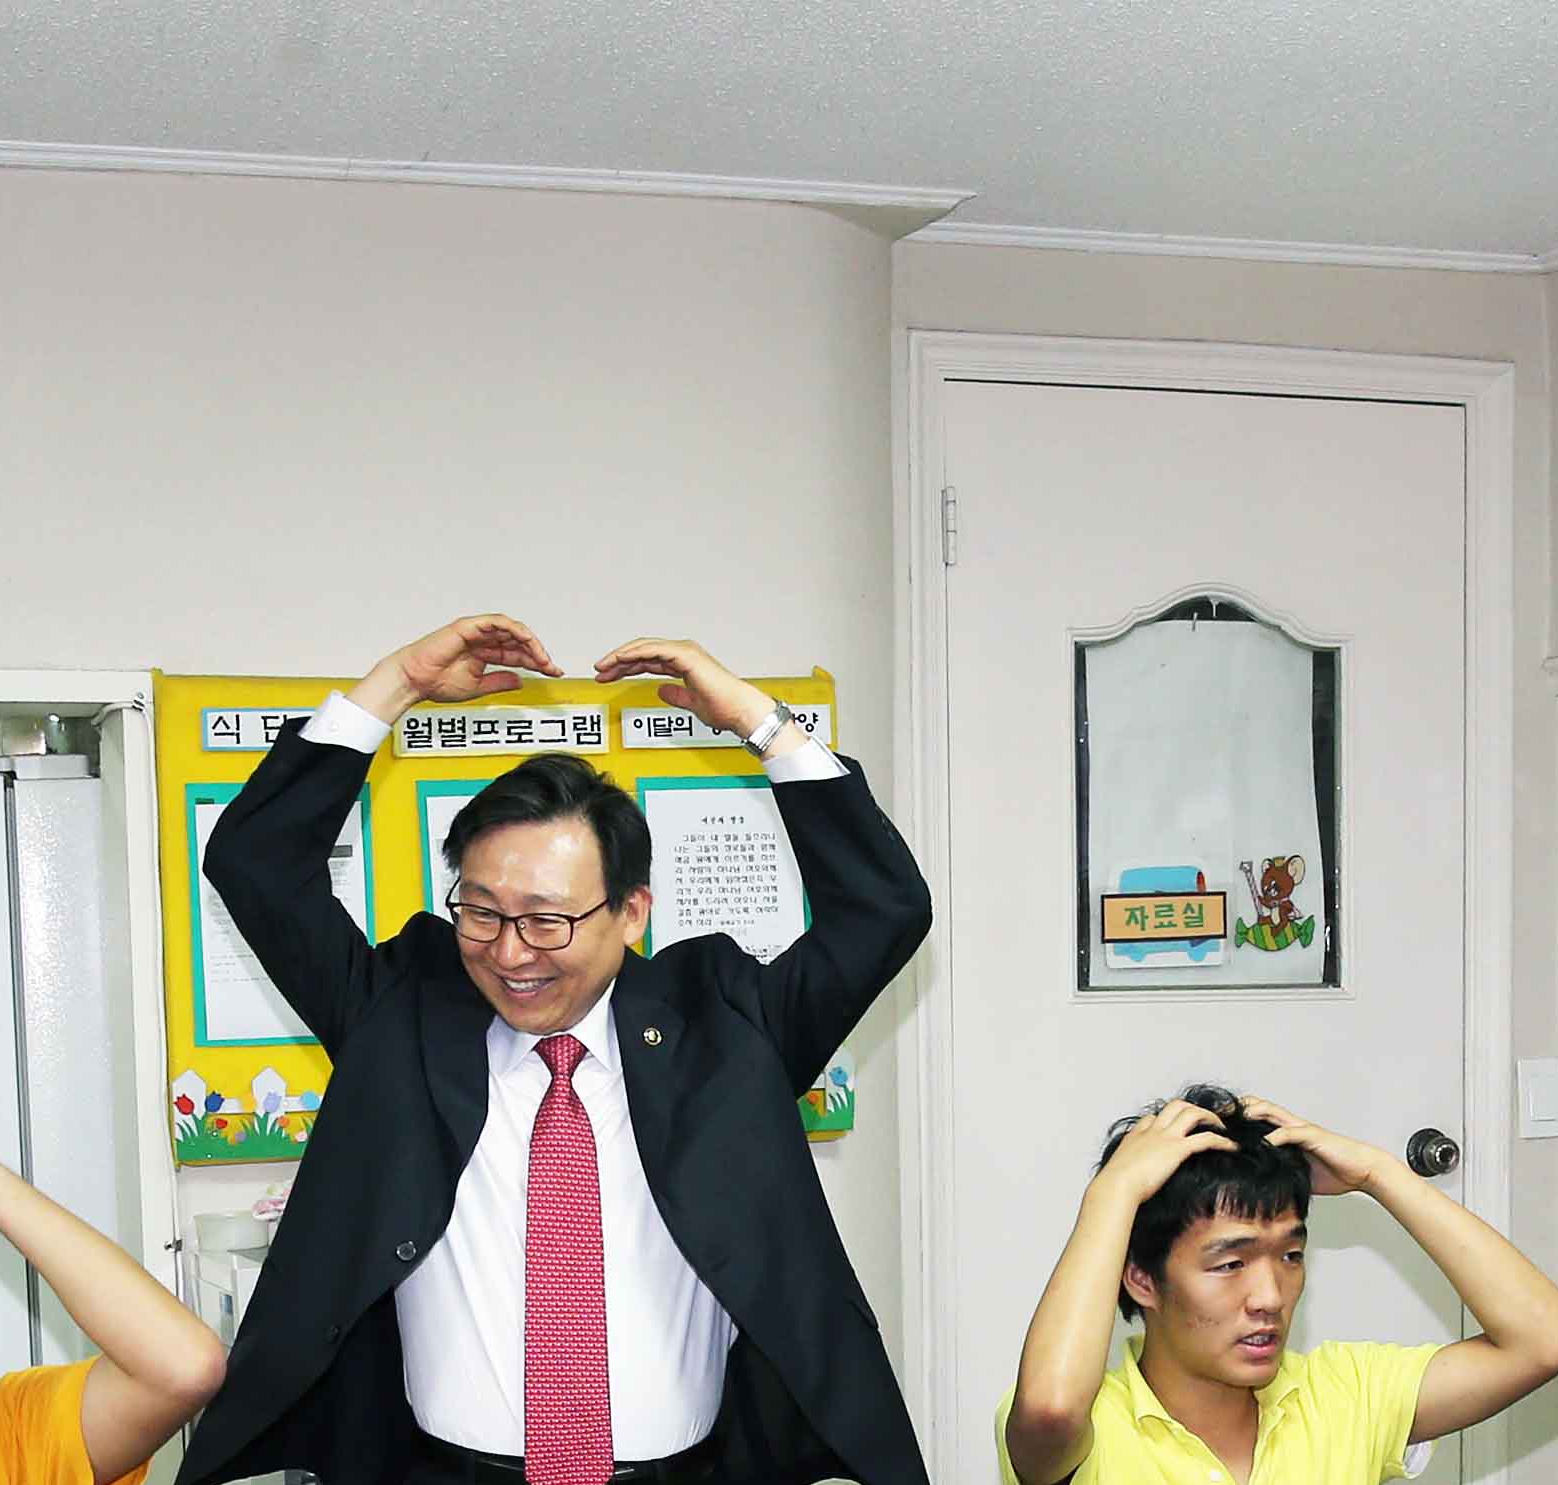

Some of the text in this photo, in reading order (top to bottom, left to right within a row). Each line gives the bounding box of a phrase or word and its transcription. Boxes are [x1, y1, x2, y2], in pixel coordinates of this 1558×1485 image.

[403, 715, 602, 749] 월별프로그램
[633, 715, 693, 738] 이달의
[1124, 902, 1204, 931] 자료실
